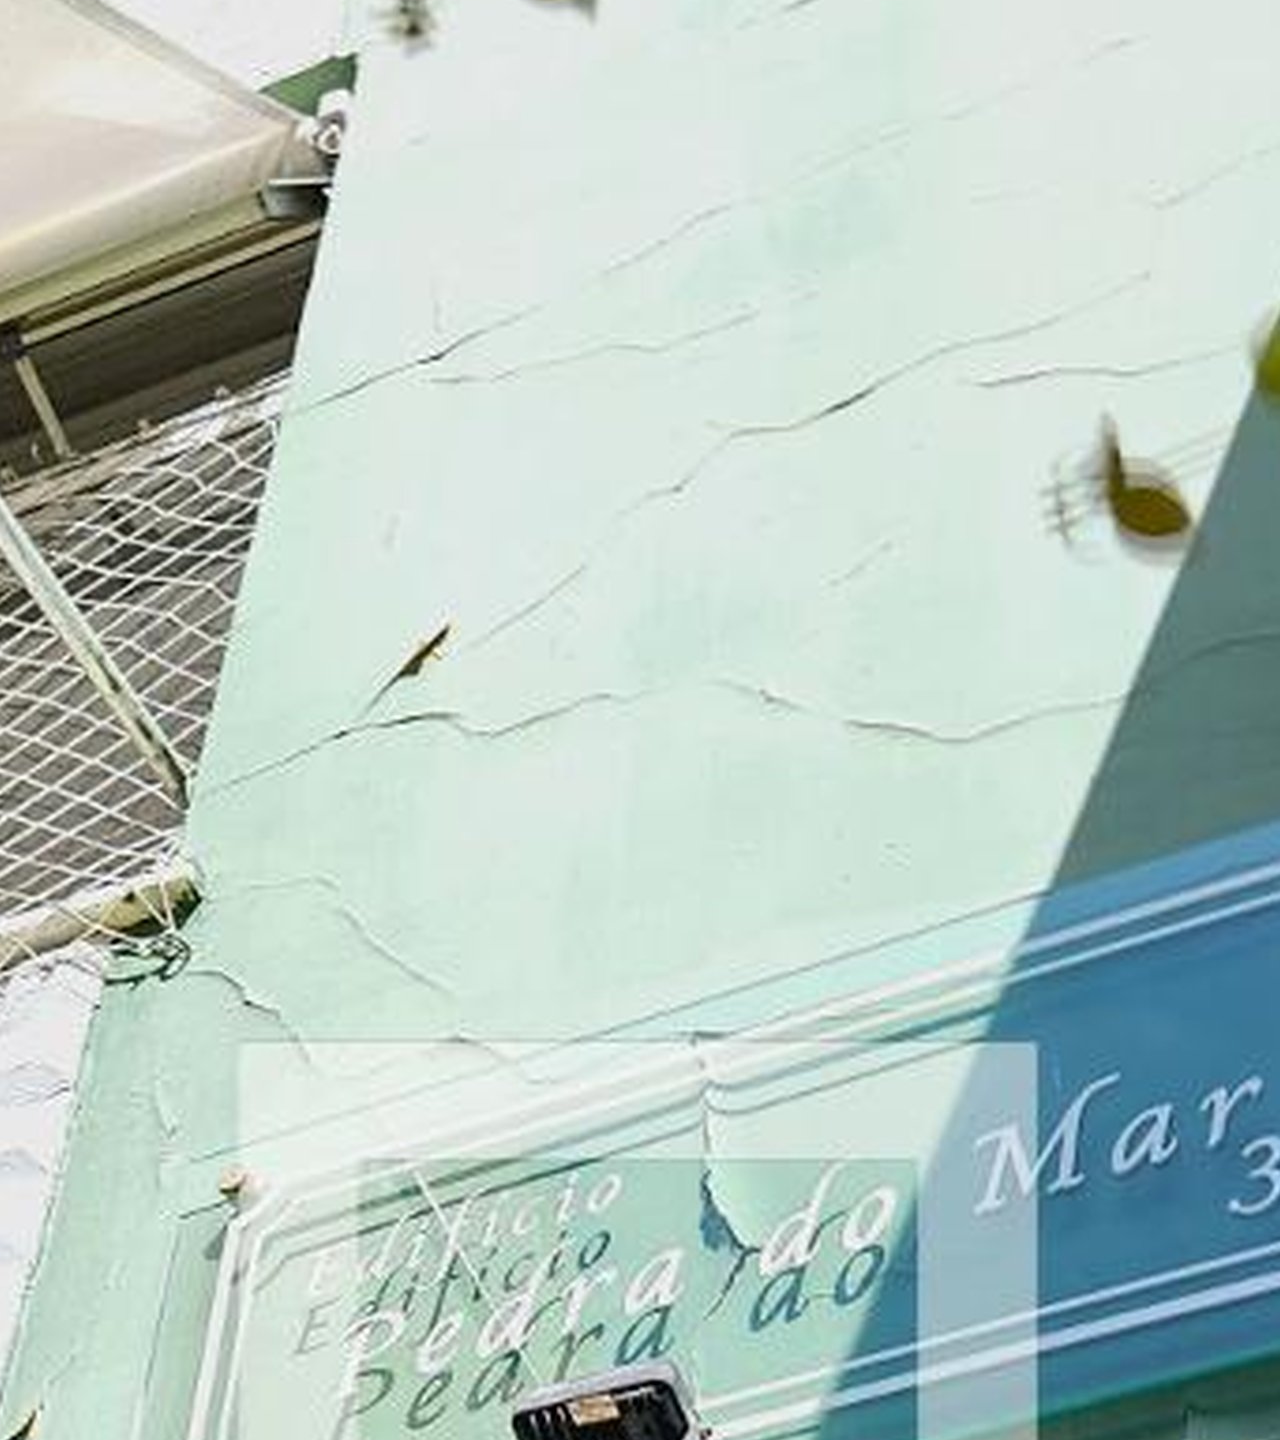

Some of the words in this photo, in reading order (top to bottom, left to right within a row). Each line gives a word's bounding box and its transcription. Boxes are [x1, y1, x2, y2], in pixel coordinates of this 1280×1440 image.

[334, 1228, 686, 1398] Pedra
[757, 1153, 897, 1277] do
[971, 1071, 1263, 1217] Mar
